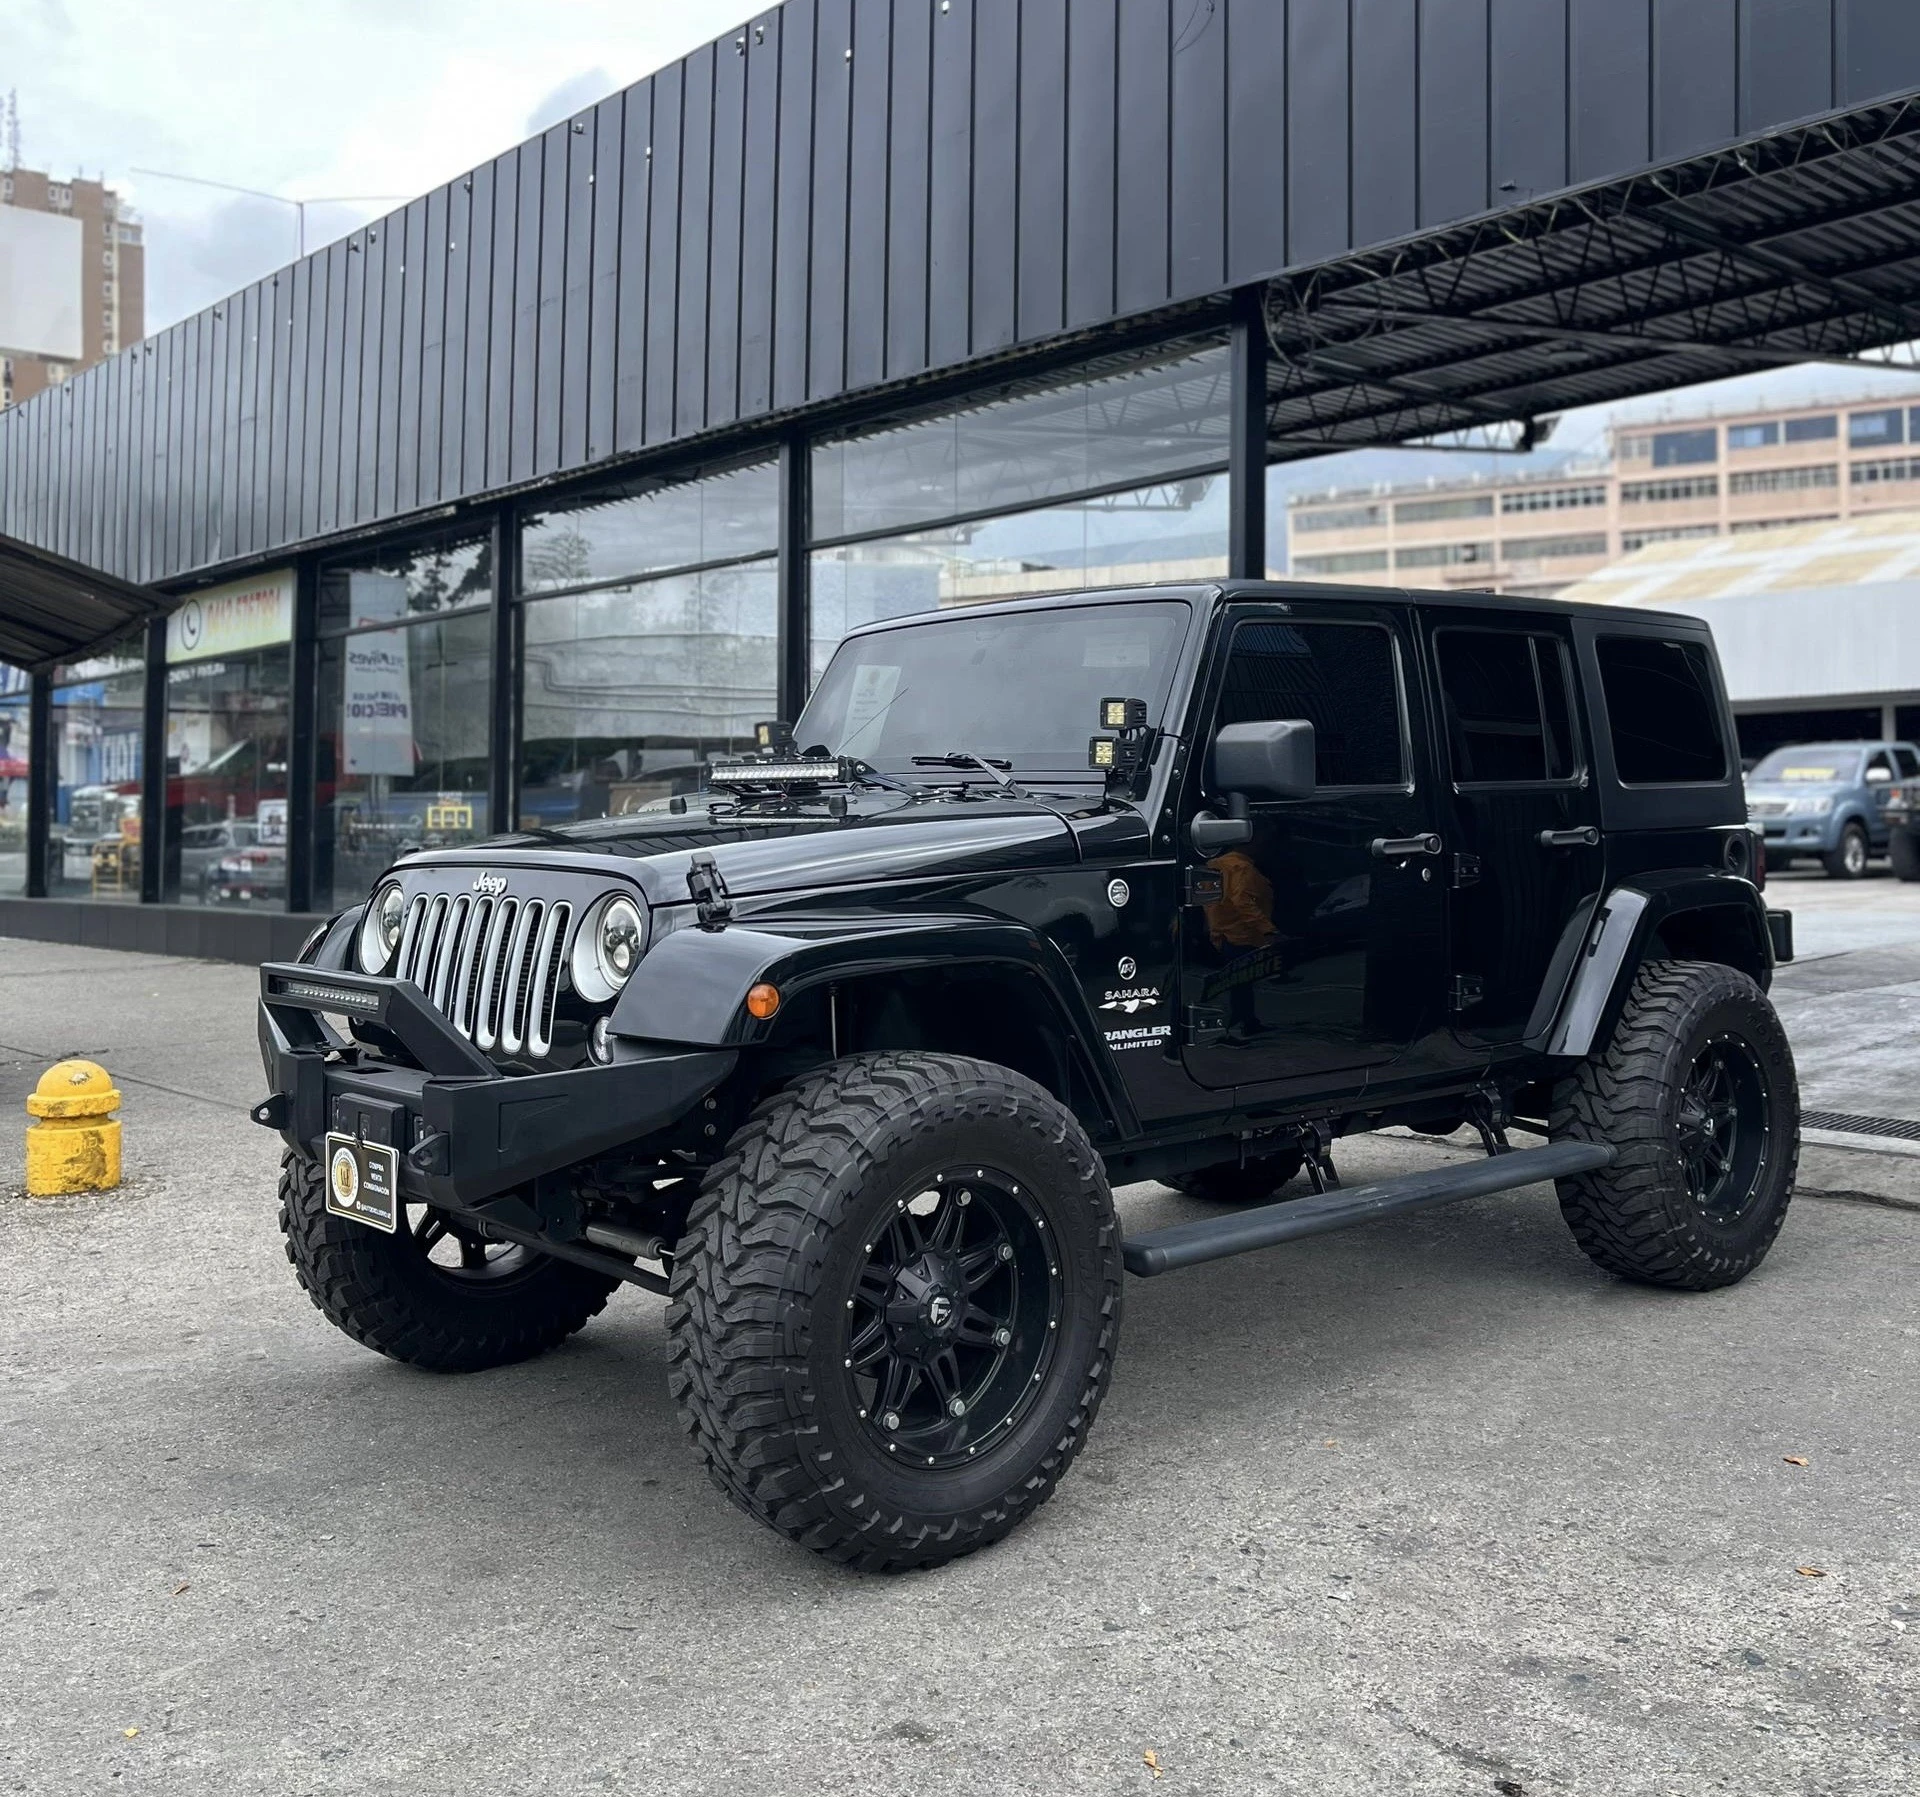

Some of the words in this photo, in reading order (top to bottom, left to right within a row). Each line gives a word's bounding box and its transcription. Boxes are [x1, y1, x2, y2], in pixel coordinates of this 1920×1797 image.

[472, 871, 508, 897] Jeep
[1104, 987, 1160, 1000] SAHARA
[1103, 1025, 1172, 1040] RANGLER
[1109, 1039, 1162, 1051] NLIMITED
